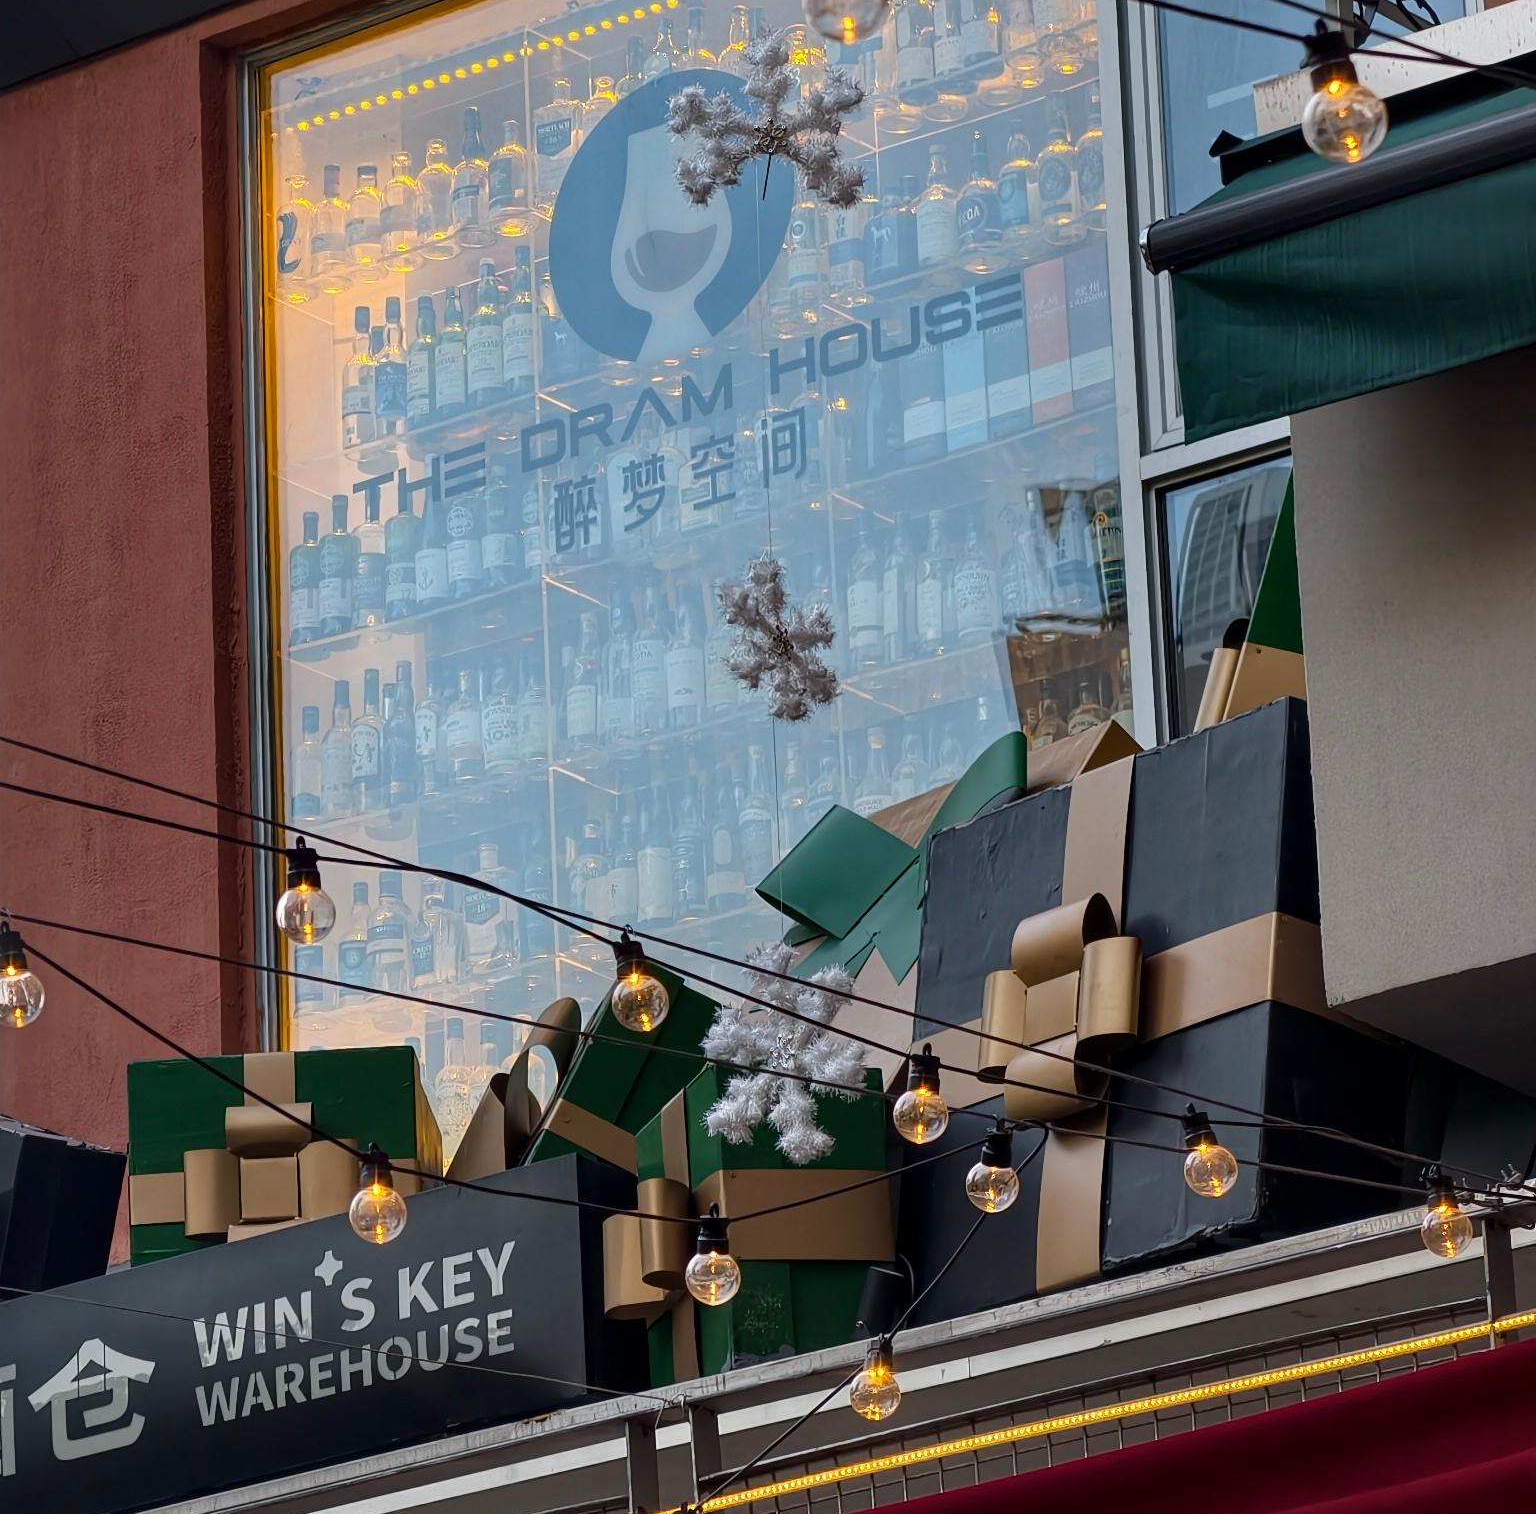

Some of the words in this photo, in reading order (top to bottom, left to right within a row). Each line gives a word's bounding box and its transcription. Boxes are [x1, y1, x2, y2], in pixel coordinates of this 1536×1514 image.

[352, 441, 486, 522] THE
[521, 362, 733, 473] DRAM
[769, 272, 1023, 395] HOUSE
[553, 406, 807, 554] 醉梦空间
[397, 1240, 516, 1320] KEY
[194, 1308, 515, 1427] WAREHOUSE
